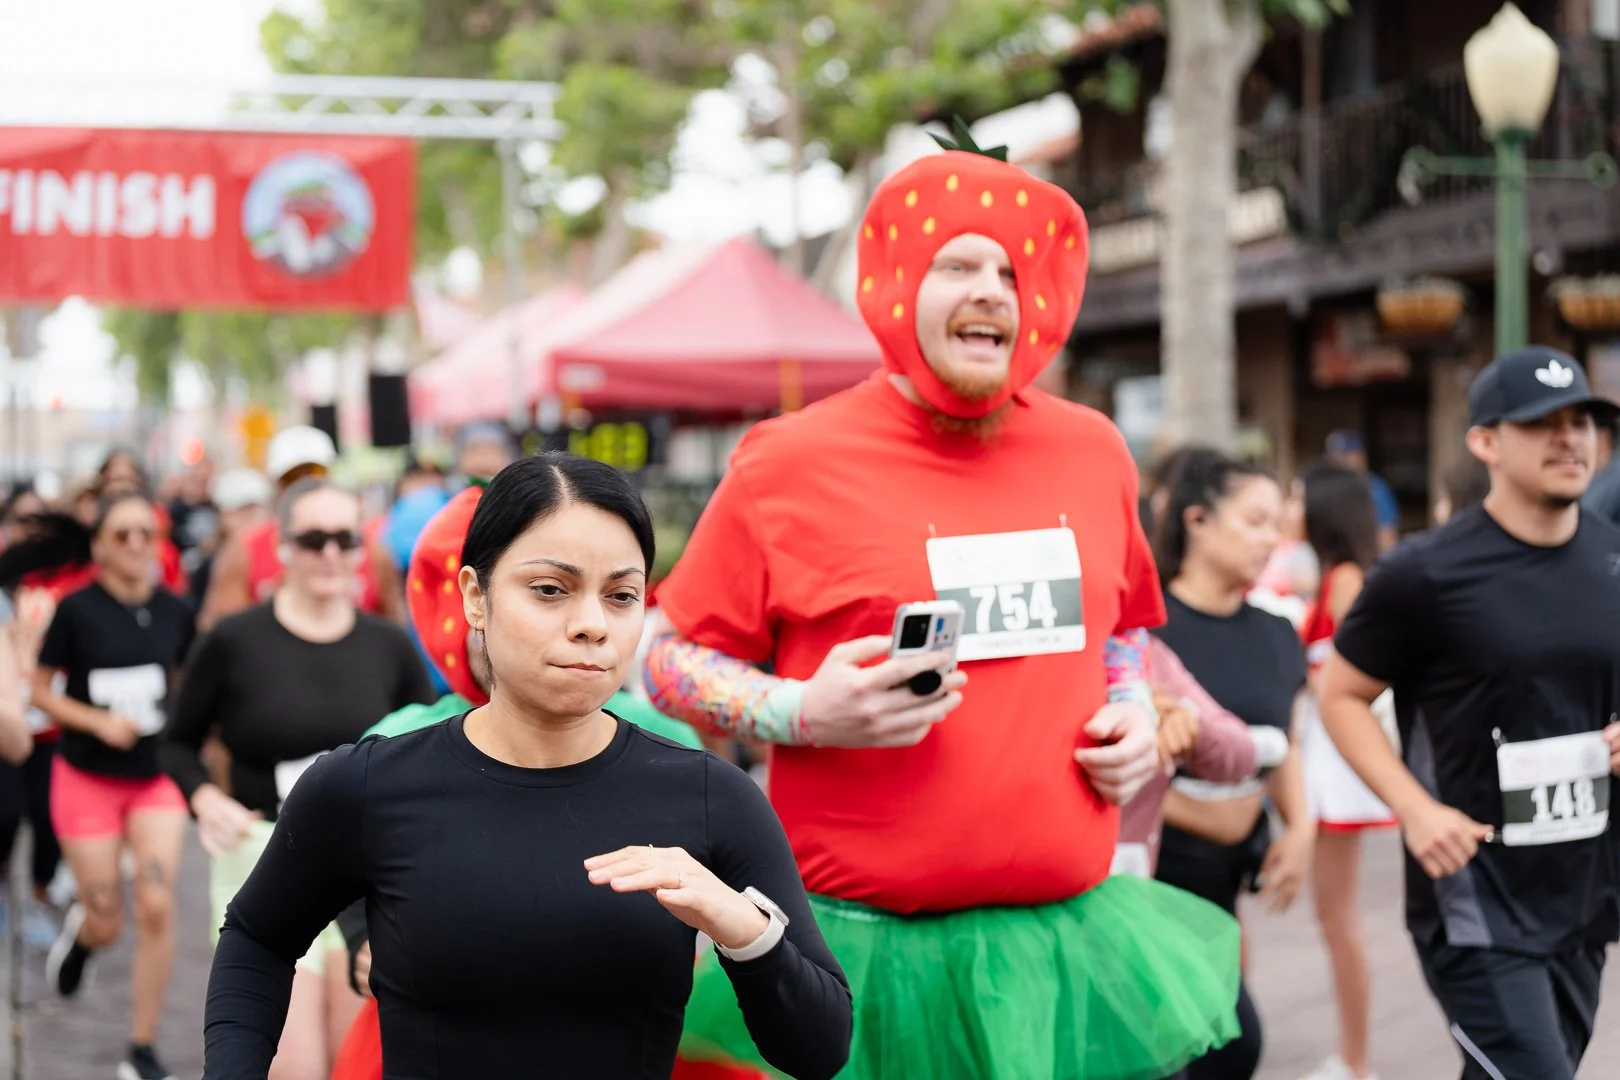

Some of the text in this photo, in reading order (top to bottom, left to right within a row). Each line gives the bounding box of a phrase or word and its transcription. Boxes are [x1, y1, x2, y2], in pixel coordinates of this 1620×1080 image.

[0, 169, 216, 239] INISH
[969, 581, 1058, 633] 754
[1531, 777, 1596, 823] 148
